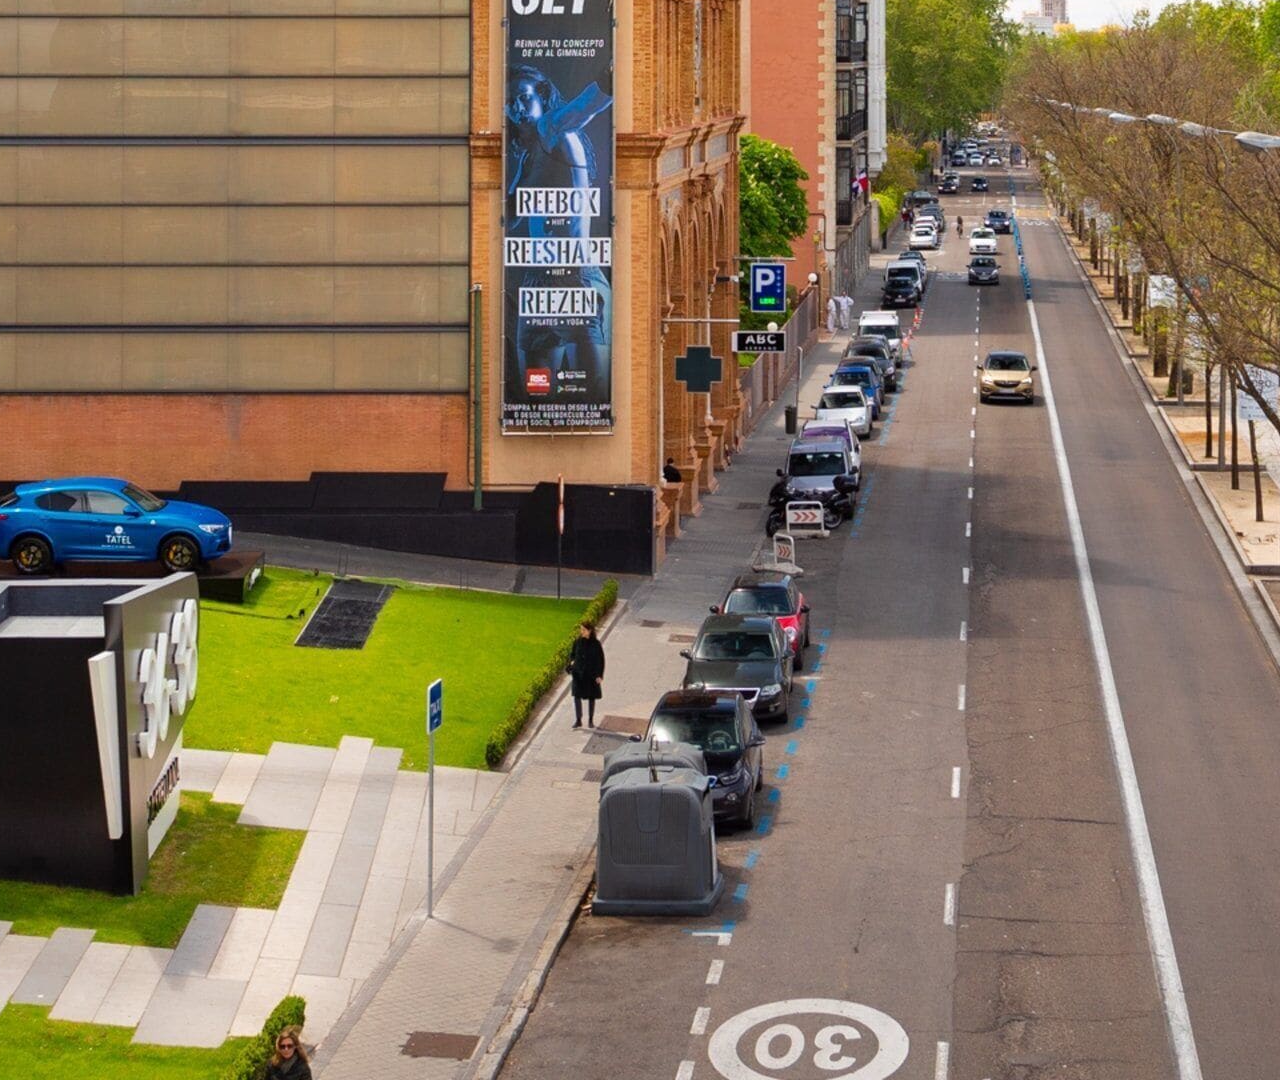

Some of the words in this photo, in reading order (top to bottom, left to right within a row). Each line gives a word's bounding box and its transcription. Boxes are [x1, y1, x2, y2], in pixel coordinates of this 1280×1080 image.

[514, 39, 549, 48] REINICIA
[551, 39, 561, 48] TU
[563, 39, 605, 48] CONCEPTO
[522, 49, 532, 57] DE
[534, 49, 543, 57] IR
[545, 49, 554, 57] AL
[556, 49, 596, 57] GIMNASIO
[506, 240, 610, 263] REESHAPE
[755, 268, 776, 293] P
[521, 289, 596, 314] REEZEN
[531, 318, 558, 326] PILATES
[566, 318, 584, 326] YOGA
[745, 334, 777, 345] ABC
[515, 418, 529, 426] SER
[553, 418, 564, 426] SIN
[105, 534, 132, 545] TATEL
[754, 1023, 862, 1071] 30
